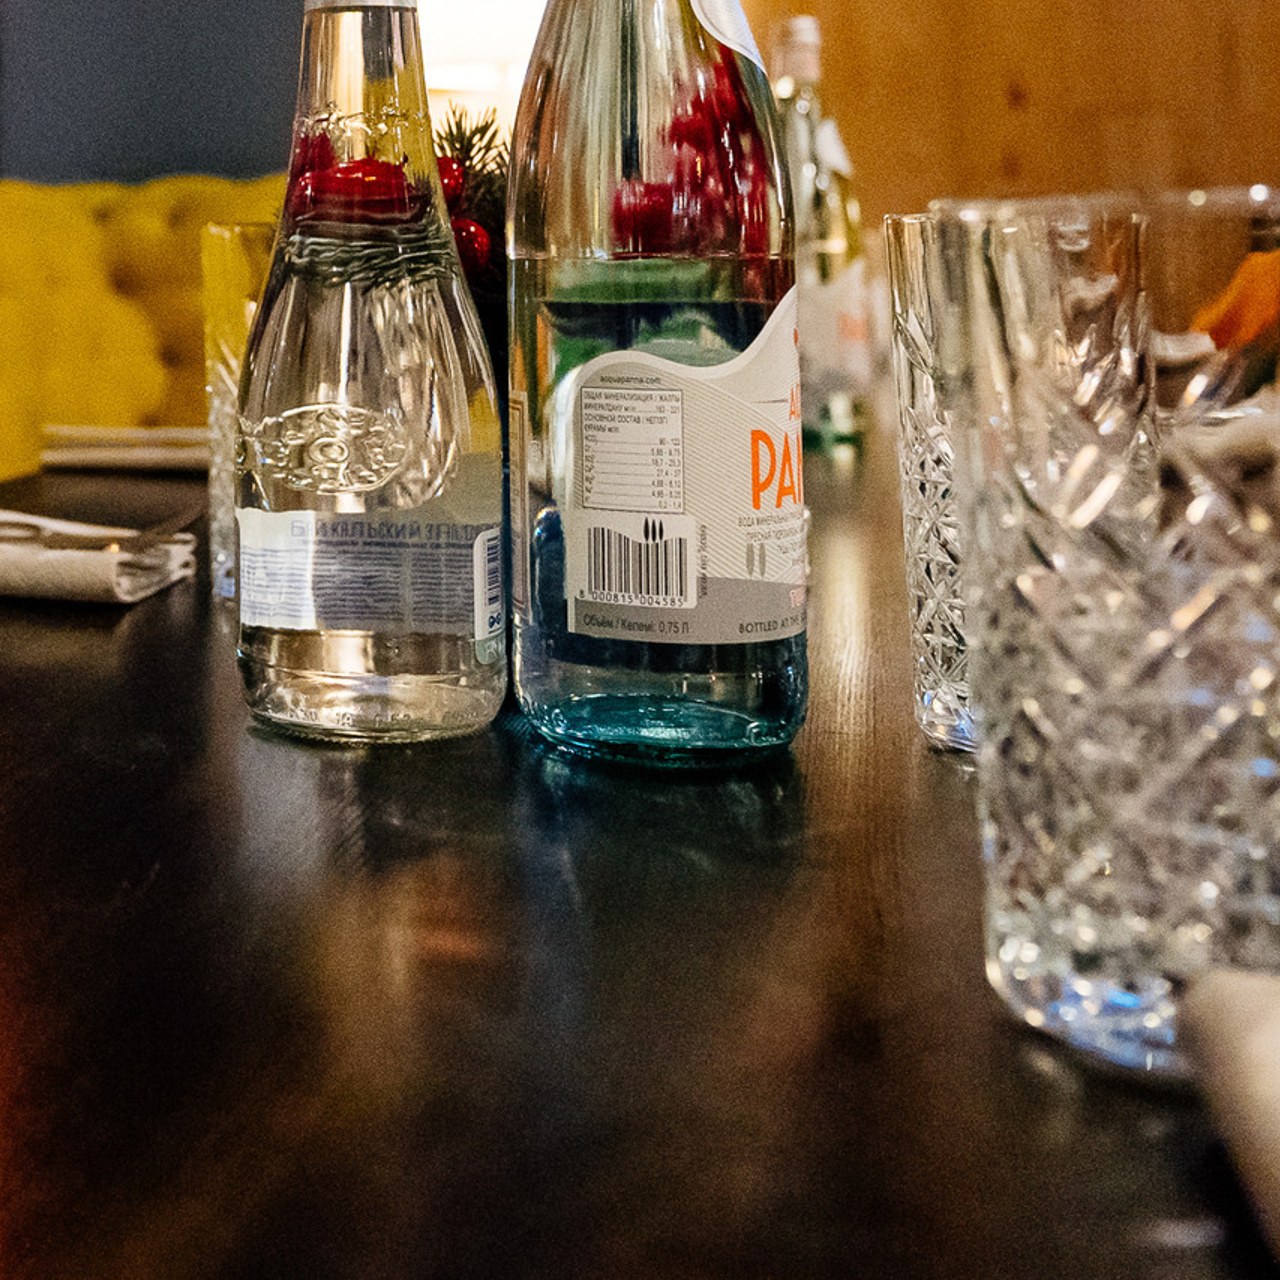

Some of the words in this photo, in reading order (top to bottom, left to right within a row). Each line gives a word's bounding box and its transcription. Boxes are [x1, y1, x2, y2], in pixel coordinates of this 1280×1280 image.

[579, 589, 586, 599] 8
[591, 591, 634, 604] 000815
[639, 596, 684, 607] 004585
[659, 621, 680, 635] 0,75
[739, 619, 778, 634] BOTTLED
